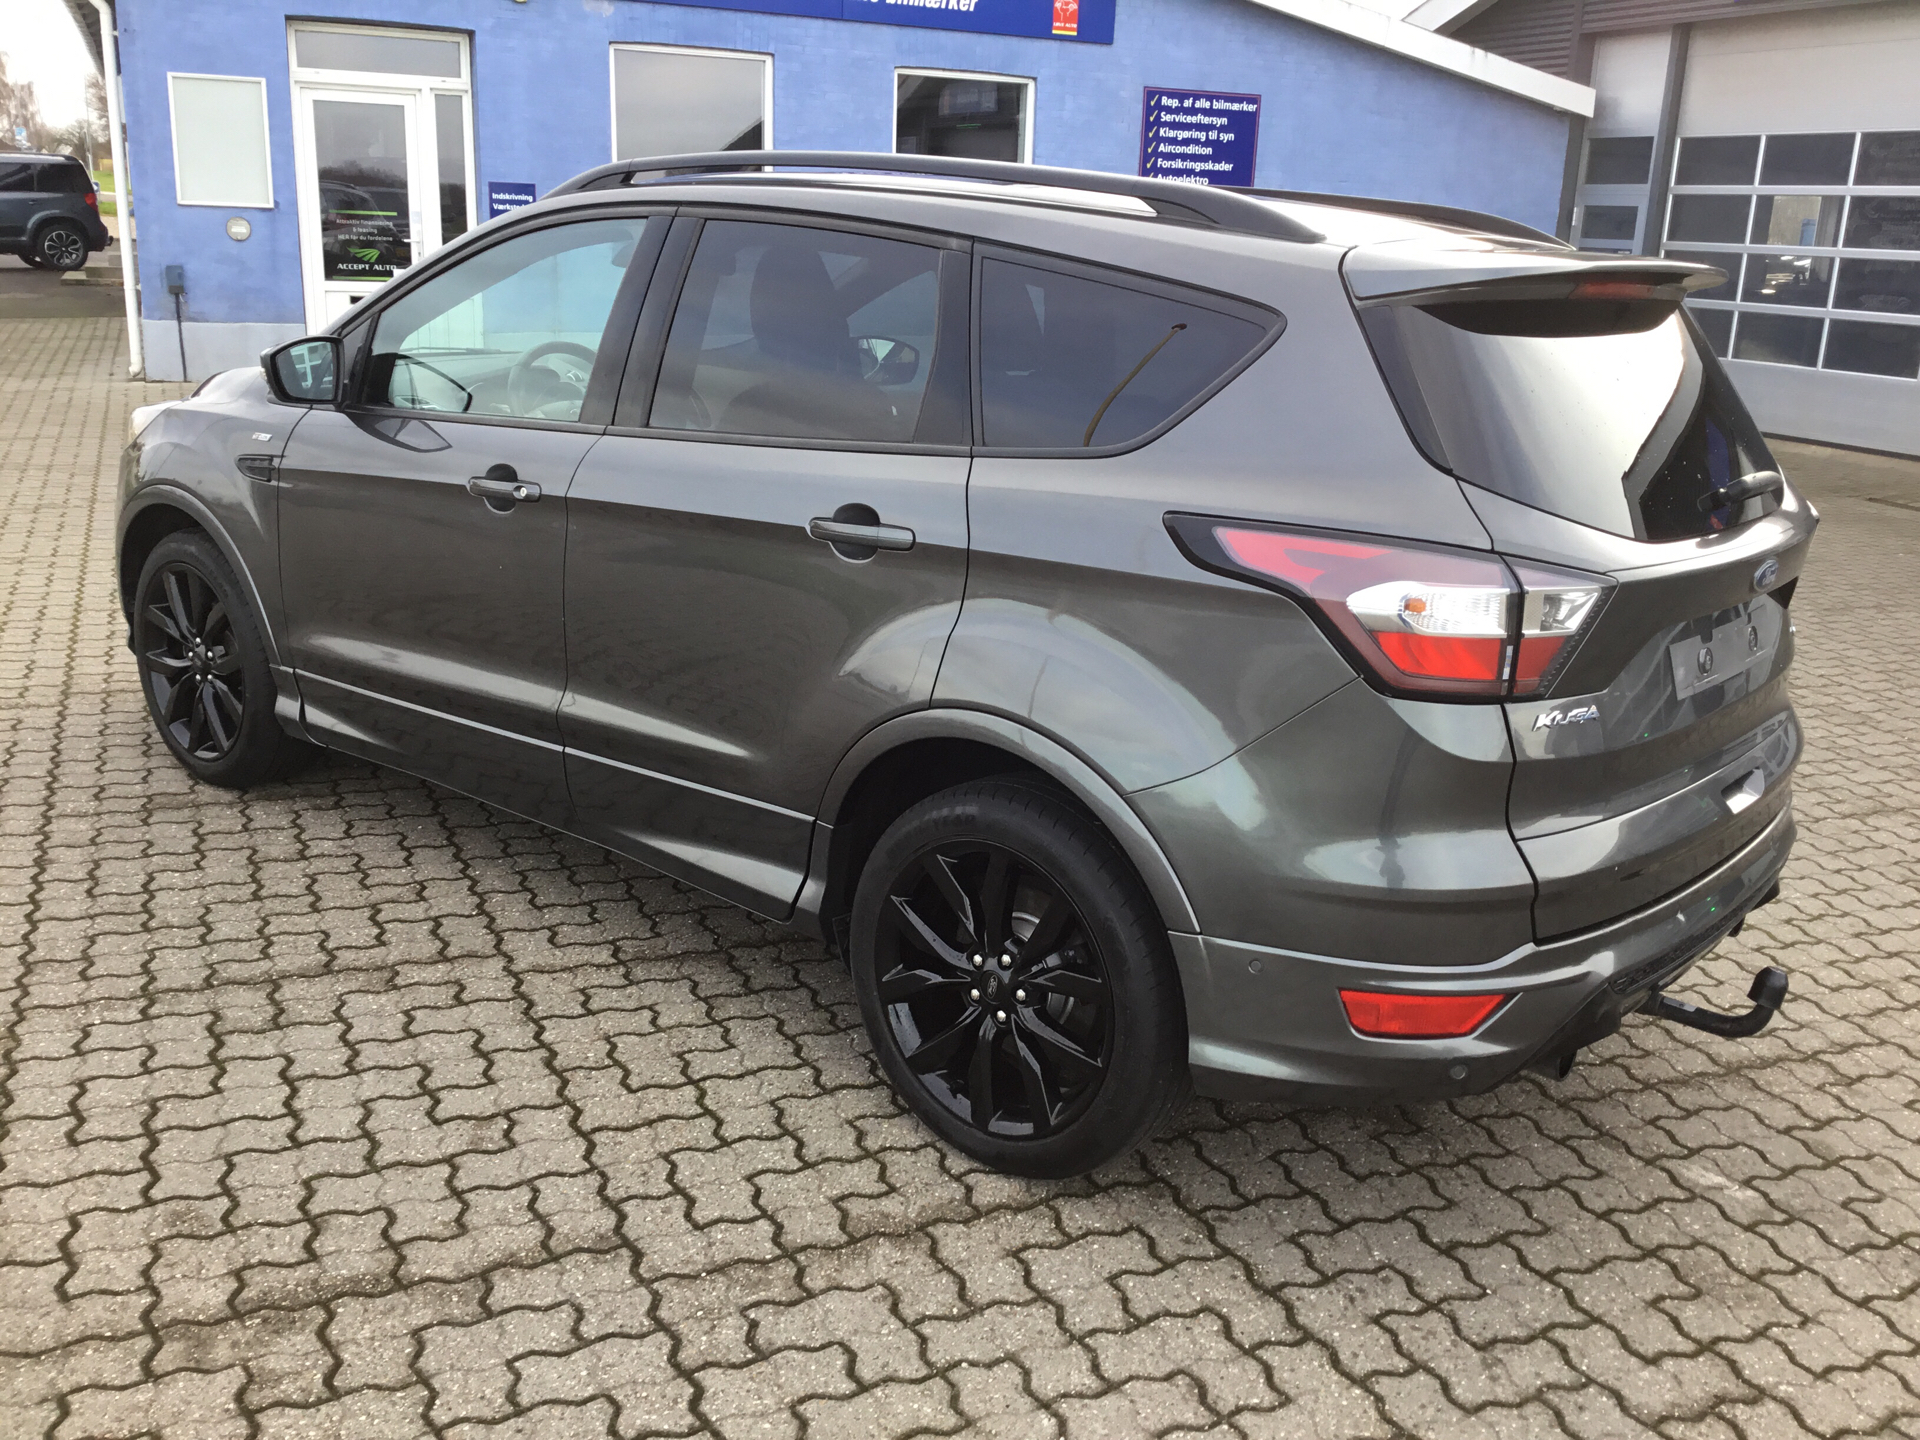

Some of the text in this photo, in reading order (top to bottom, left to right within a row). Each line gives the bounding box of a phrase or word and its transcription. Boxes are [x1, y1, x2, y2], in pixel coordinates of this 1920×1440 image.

[1161, 96, 1258, 112] Rep. af alle bilmærker
[1160, 112, 1228, 127] Serviceeftersyn
[1160, 127, 1235, 143] Klargøring til syn
[1158, 143, 1213, 155] Aircondition
[1157, 158, 1234, 172] Forsikringsskader
[492, 193, 533, 203] Indskrivning
